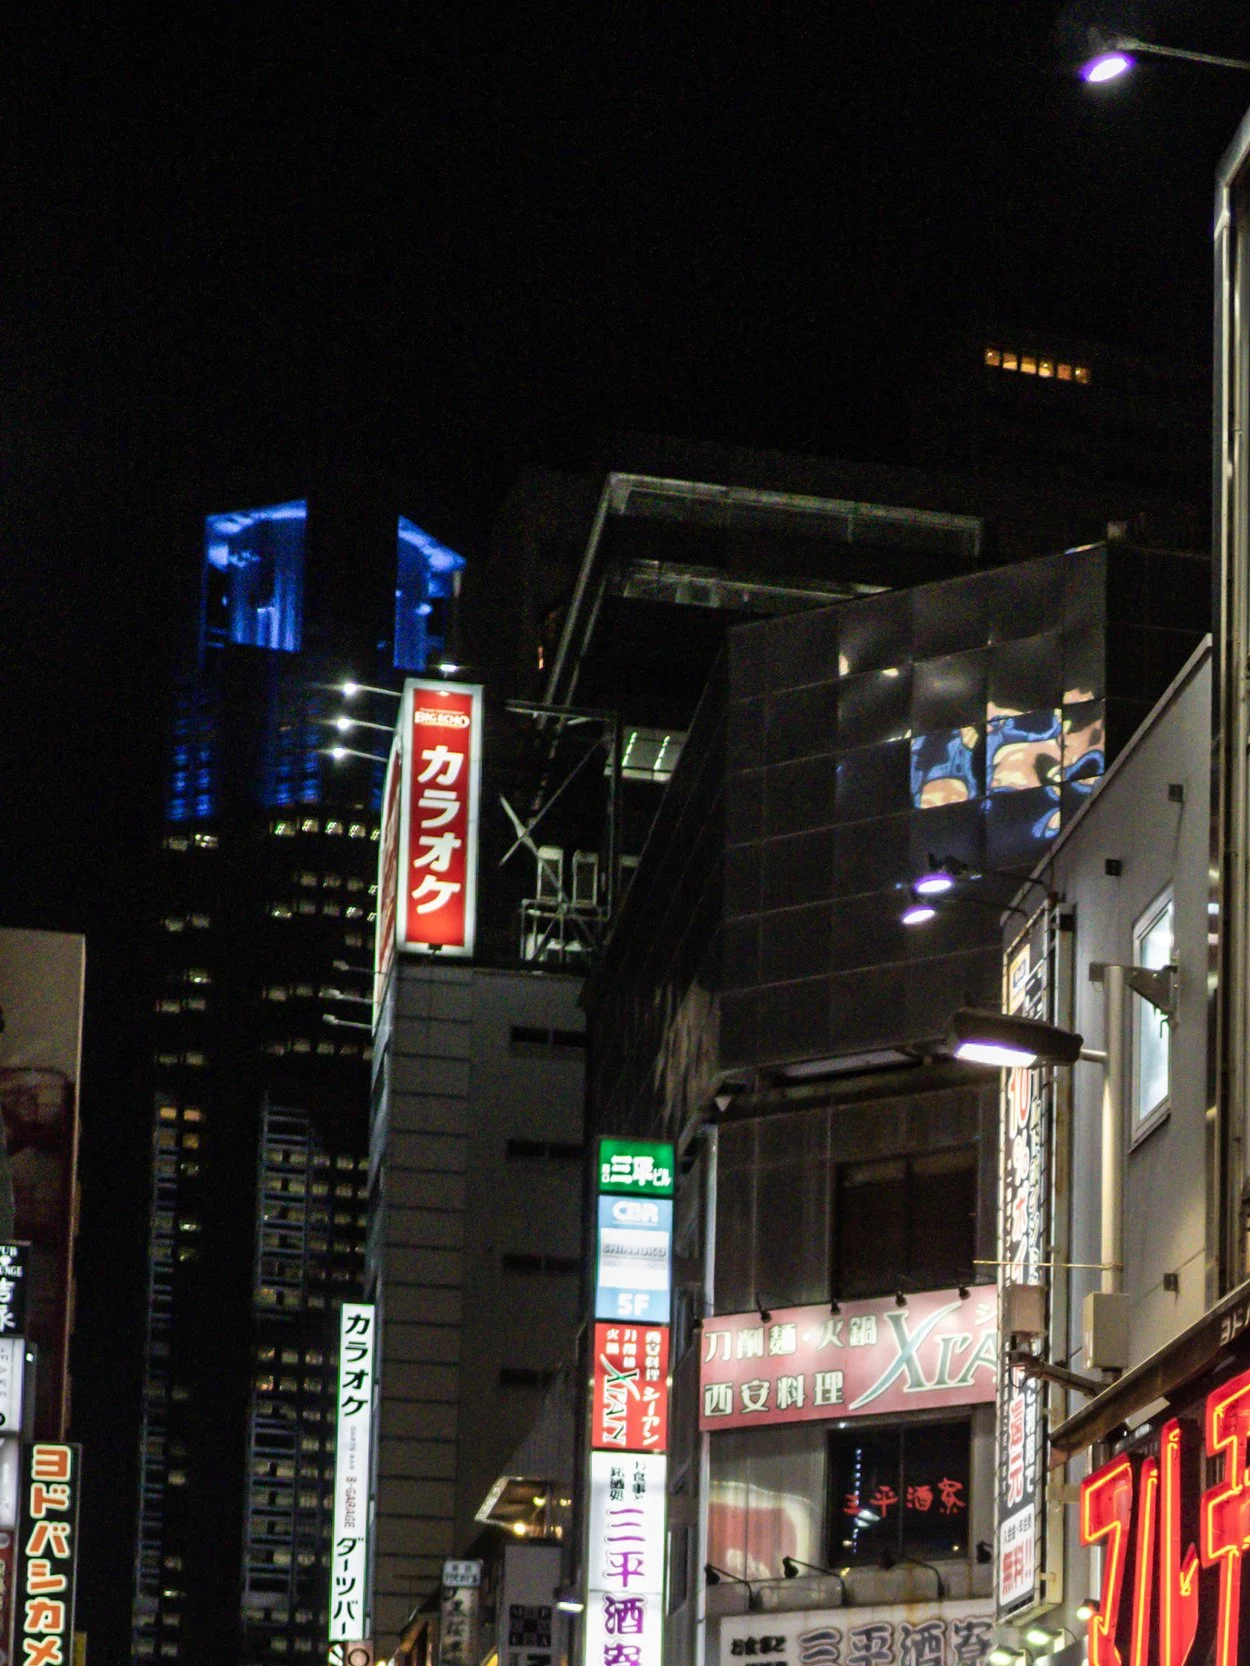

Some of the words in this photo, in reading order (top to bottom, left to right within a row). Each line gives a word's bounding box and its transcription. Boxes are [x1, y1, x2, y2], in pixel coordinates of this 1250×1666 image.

[411, 745, 464, 914] カラオケ
[616, 1293, 650, 1316] 5F
[341, 1313, 370, 1417] カラオケ
[703, 1370, 845, 1417] 西安料理
[642, 1385, 661, 1446] シーアン
[333, 1536, 364, 1636] ダーツバー
